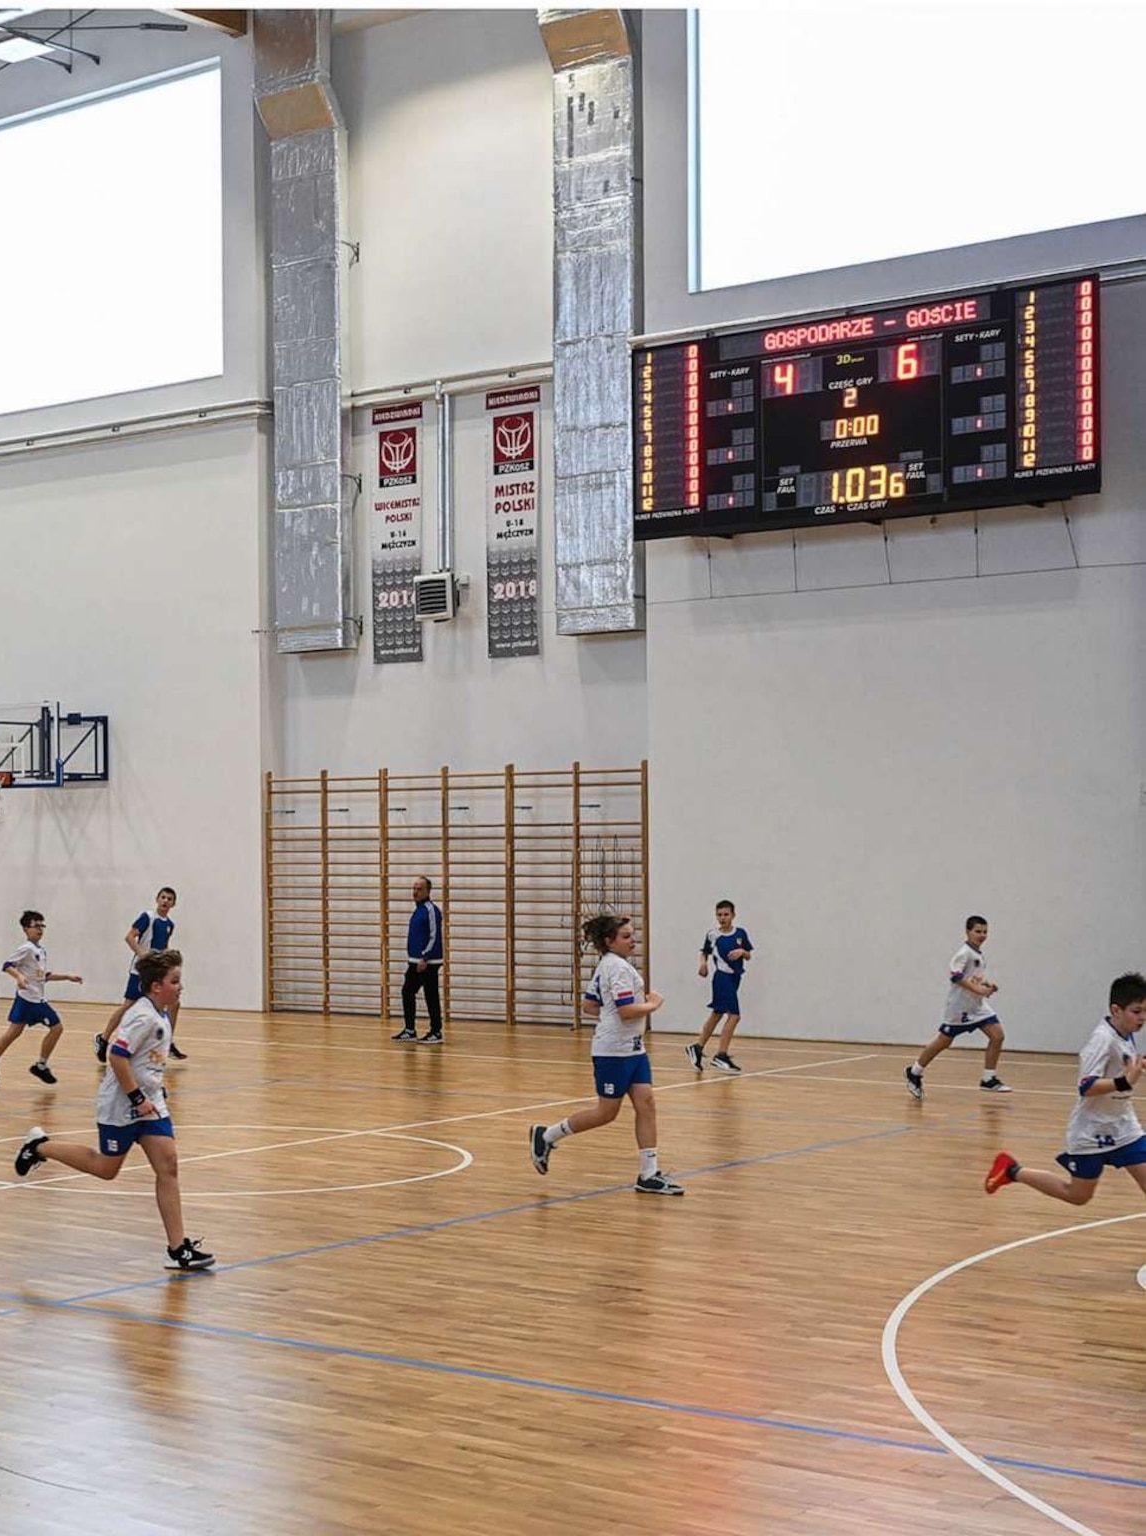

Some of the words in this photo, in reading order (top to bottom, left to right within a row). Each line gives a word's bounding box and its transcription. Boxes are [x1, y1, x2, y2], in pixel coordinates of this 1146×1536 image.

[1081, 281, 1092, 295] 0
[1029, 291, 1035, 304] 1
[1081, 296, 1092, 310] 0
[1025, 306, 1035, 319] 2
[1082, 312, 1092, 325] 0
[1025, 321, 1035, 334] 3
[1082, 327, 1092, 340] 0
[764, 317, 874, 351] GOSPODARZE
[954, 332, 974, 342] SETY
[979, 328, 1001, 340] KARY
[1025, 336, 1035, 347] 4
[688, 345, 698, 357] 0
[1082, 342, 1092, 355] 0
[647, 353, 652, 363] 1
[897, 343, 918, 380] 6
[1025, 350, 1035, 363] 5
[688, 359, 698, 371] 0
[1082, 357, 1092, 370] 0
[643, 366, 652, 377] 2
[1025, 366, 1035, 378] 6
[689, 372, 698, 384] 0
[774, 364, 794, 395] 4
[856, 376, 874, 386] GRY
[1082, 372, 1092, 385] 0
[643, 379, 652, 391] 3
[1025, 380, 1035, 392] 7
[689, 386, 698, 398] 0
[844, 387, 858, 408] 2
[1082, 387, 1092, 400] 0
[643, 393, 652, 404] 4
[1025, 395, 1035, 407] 8
[689, 399, 698, 411] 0
[1082, 401, 1093, 415] 0
[643, 406, 652, 417] 5
[1025, 409, 1035, 422] 9
[643, 420, 652, 430] 6
[689, 413, 698, 425] 0
[1082, 417, 1093, 429] 0
[689, 426, 698, 437] 0
[835, 414, 880, 439] 0:00
[643, 432, 652, 443] 7
[830, 437, 868, 448] PRZERWA
[1082, 431, 1093, 445] 0
[643, 445, 652, 456] 8
[689, 439, 698, 451] 0
[689, 453, 698, 464] 0
[1082, 446, 1093, 460] 0
[643, 459, 652, 470] 9
[908, 462, 924, 472] SET
[689, 466, 699, 477] 0
[906, 470, 926, 480] FAUL
[689, 480, 699, 491] 0
[779, 478, 794, 486] SET
[494, 481, 534, 498] MISTRZ
[776, 486, 796, 494] FAUL
[374, 497, 420, 512] WICEMISTRZ
[689, 493, 699, 506] 0
[495, 498, 534, 514] POLSKI
[814, 504, 836, 514] CZAS
[846, 501, 869, 512] CZAS
[870, 500, 888, 510] GRY
[386, 512, 412, 524] POLSKI
[493, 580, 536, 600] 2018
